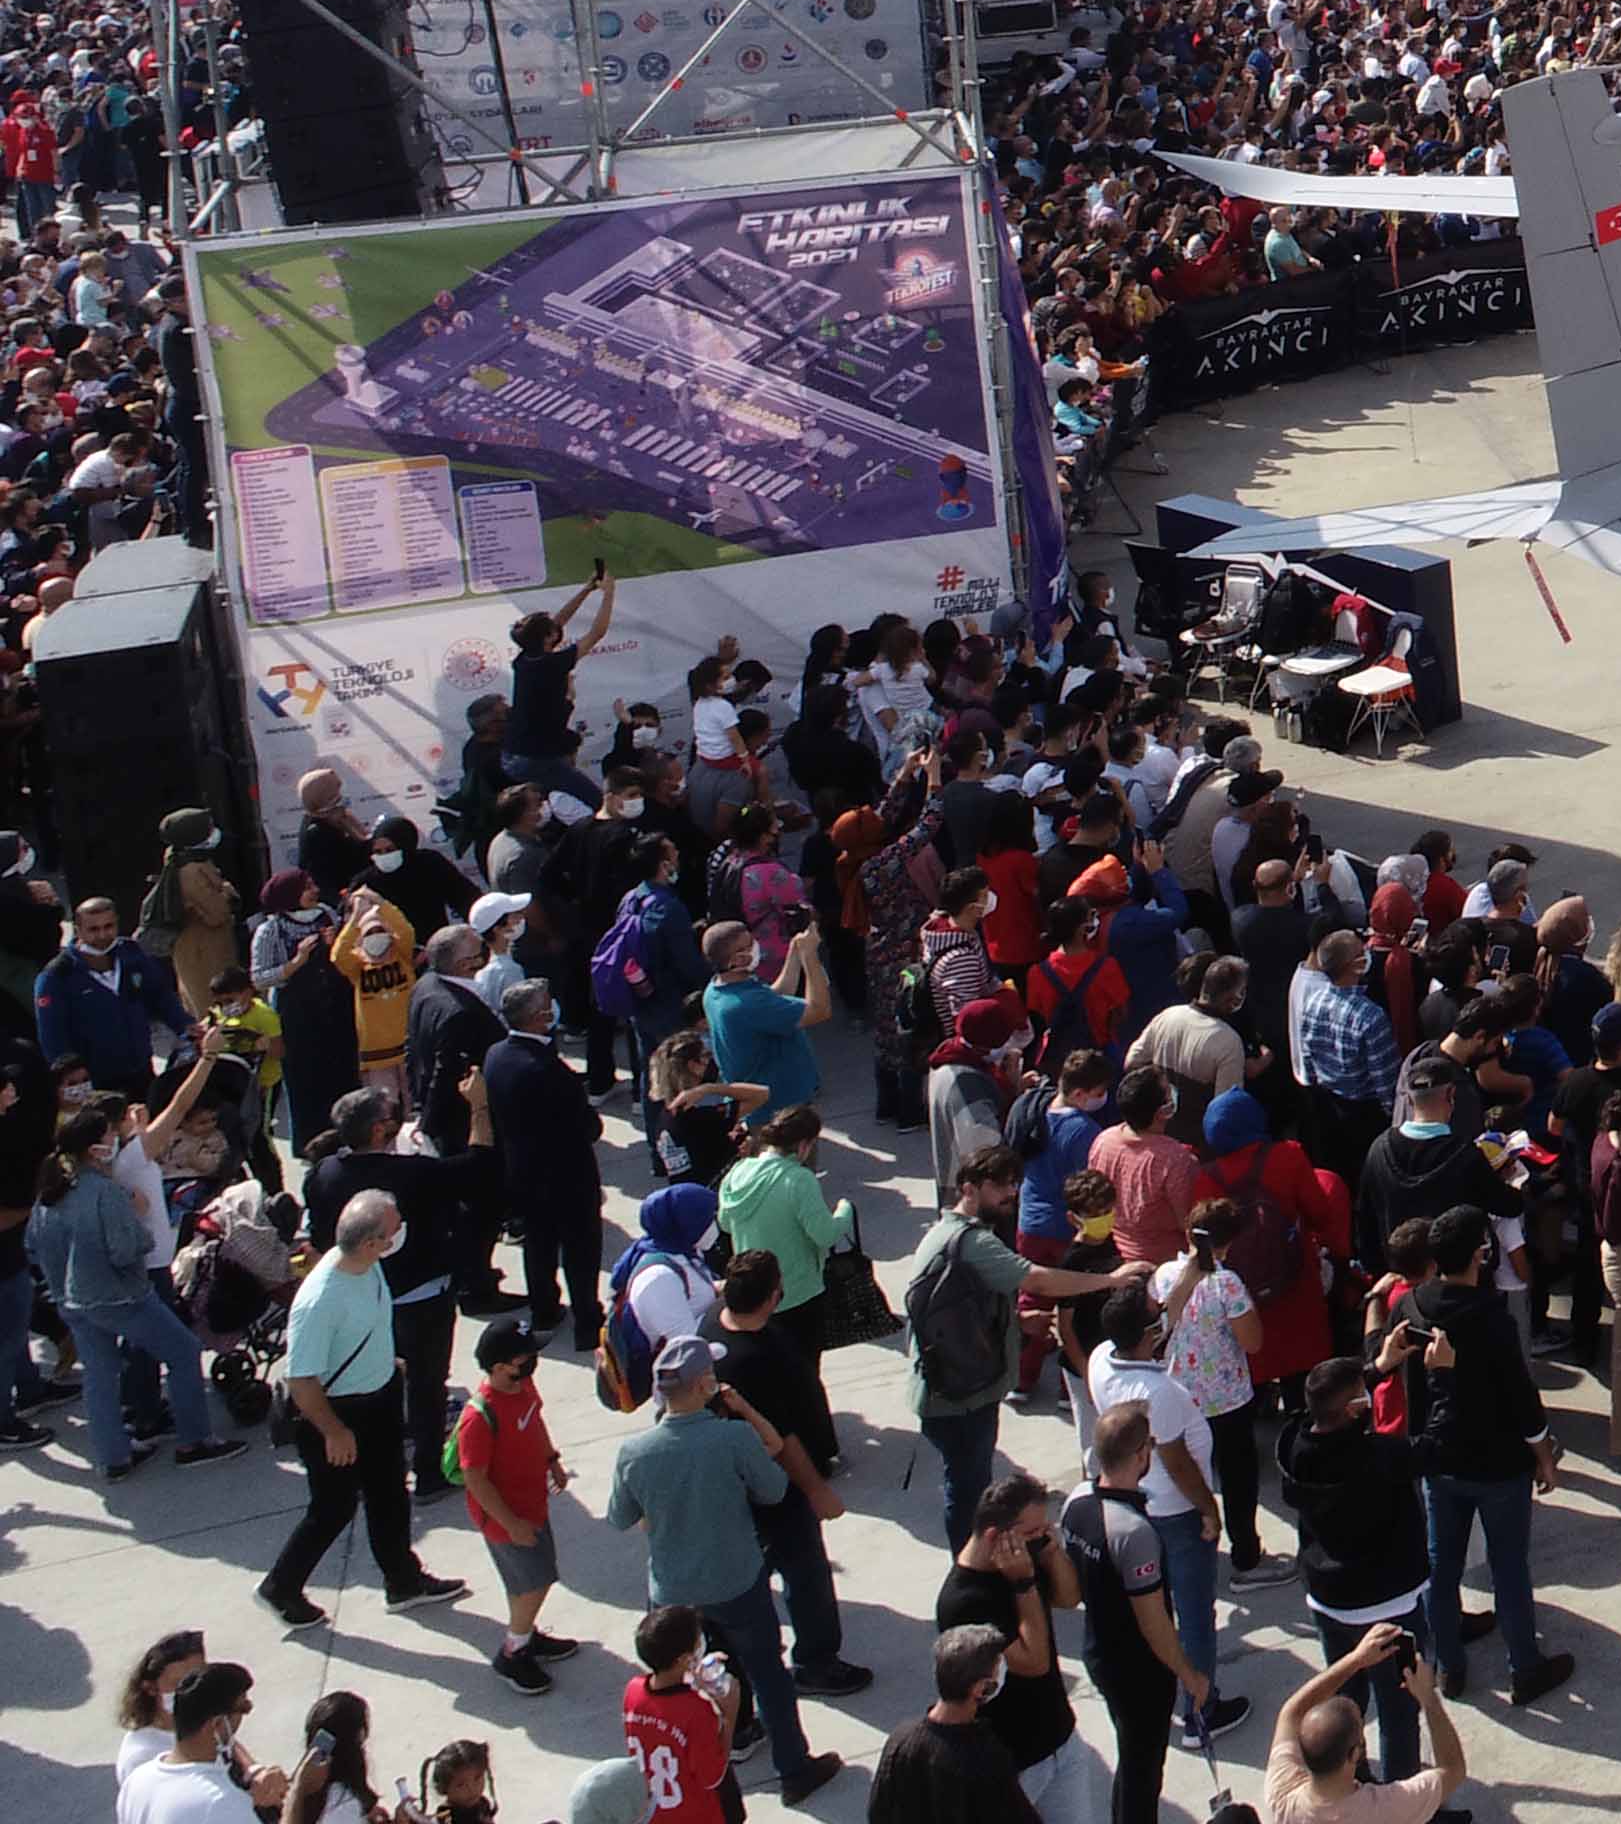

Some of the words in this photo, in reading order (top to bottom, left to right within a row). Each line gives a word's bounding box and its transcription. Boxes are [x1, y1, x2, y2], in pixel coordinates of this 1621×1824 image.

[786, 247, 859, 269] 2021
[884, 270, 952, 304] TEKNOFEST
[1400, 277, 1504, 306] BAYRAKTAR
[1379, 288, 1521, 333] AKINCI
[1216, 316, 1313, 349] BAYRAKTAR
[1195, 327, 1328, 377] AKINCI
